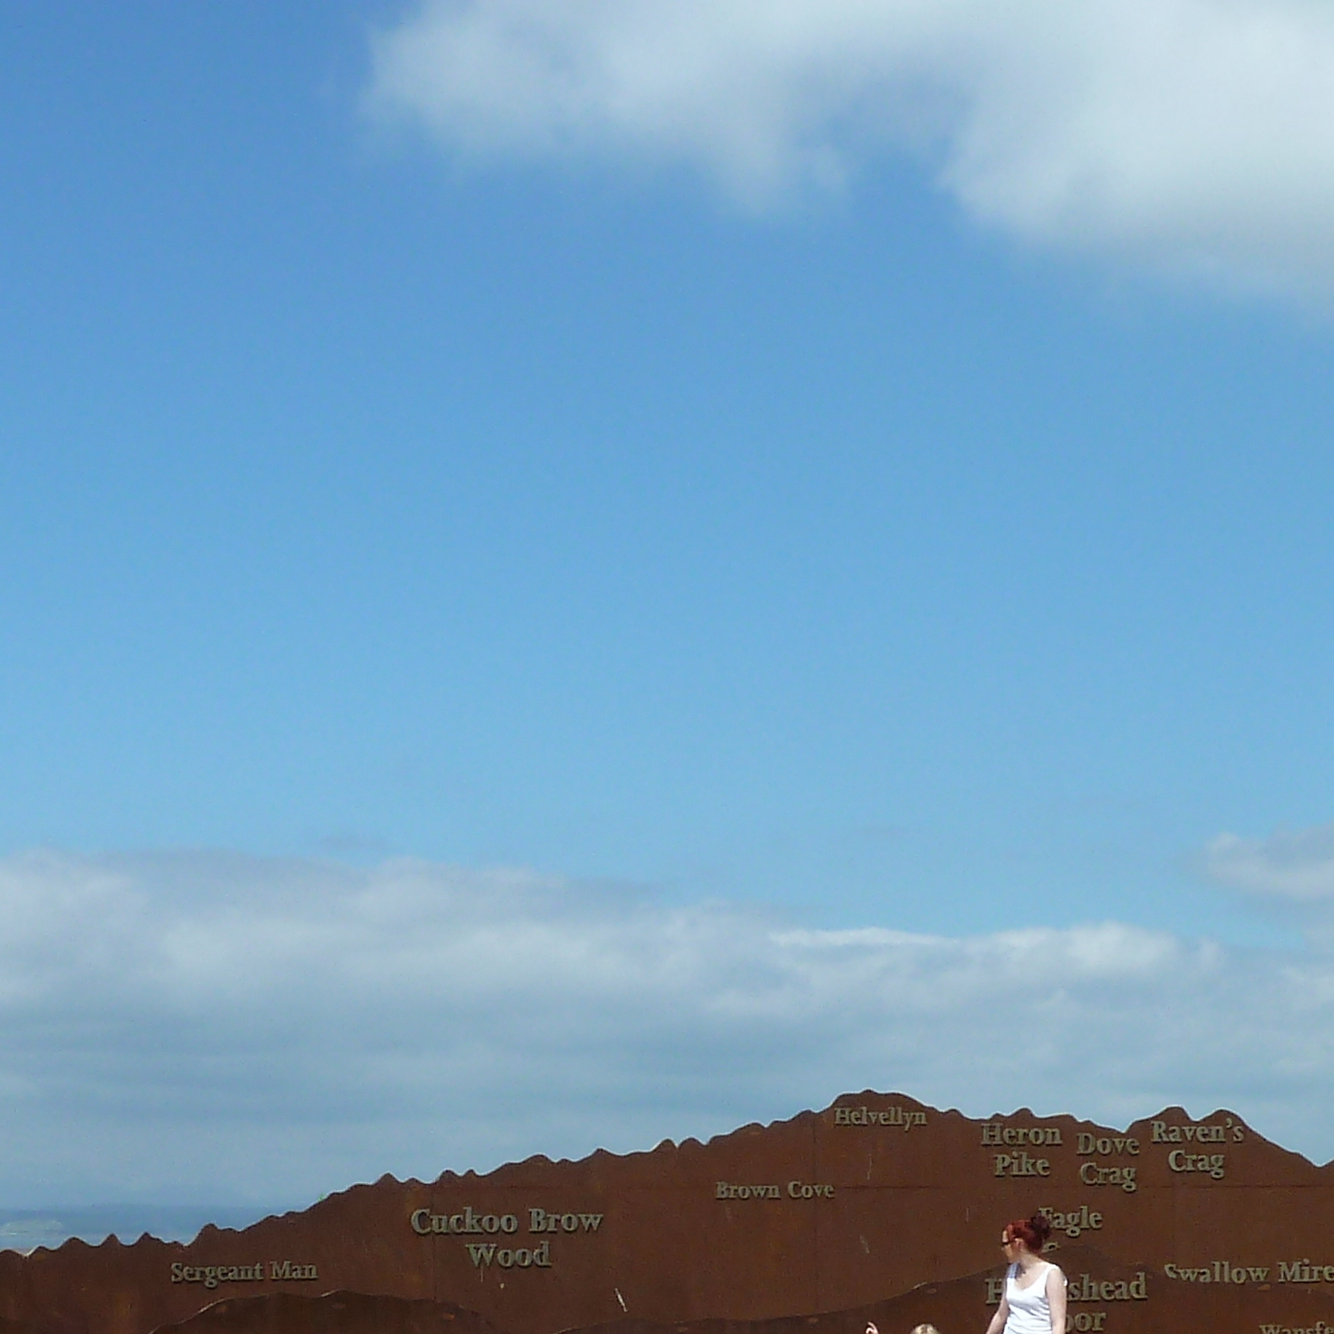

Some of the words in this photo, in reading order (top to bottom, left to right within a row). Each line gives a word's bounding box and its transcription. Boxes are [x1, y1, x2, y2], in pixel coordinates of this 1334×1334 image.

[835, 1107, 928, 1131] Helvellyn
[1151, 1118, 1245, 1143] Raven's
[981, 1122, 1062, 1146] Heron
[1076, 1132, 1140, 1156] Dove
[993, 1151, 1051, 1177] Pike
[1080, 1162, 1137, 1191] Crag
[1169, 1149, 1225, 1179] Crag
[716, 1181, 781, 1199] Brown
[788, 1181, 835, 1198] Cove
[411, 1207, 517, 1234] Cuckoo
[529, 1208, 603, 1232] Brow
[466, 1240, 552, 1268] Wood
[171, 1262, 264, 1288] Sergeant
[270, 1261, 318, 1280] Man
[1164, 1261, 1270, 1284] Swallow
